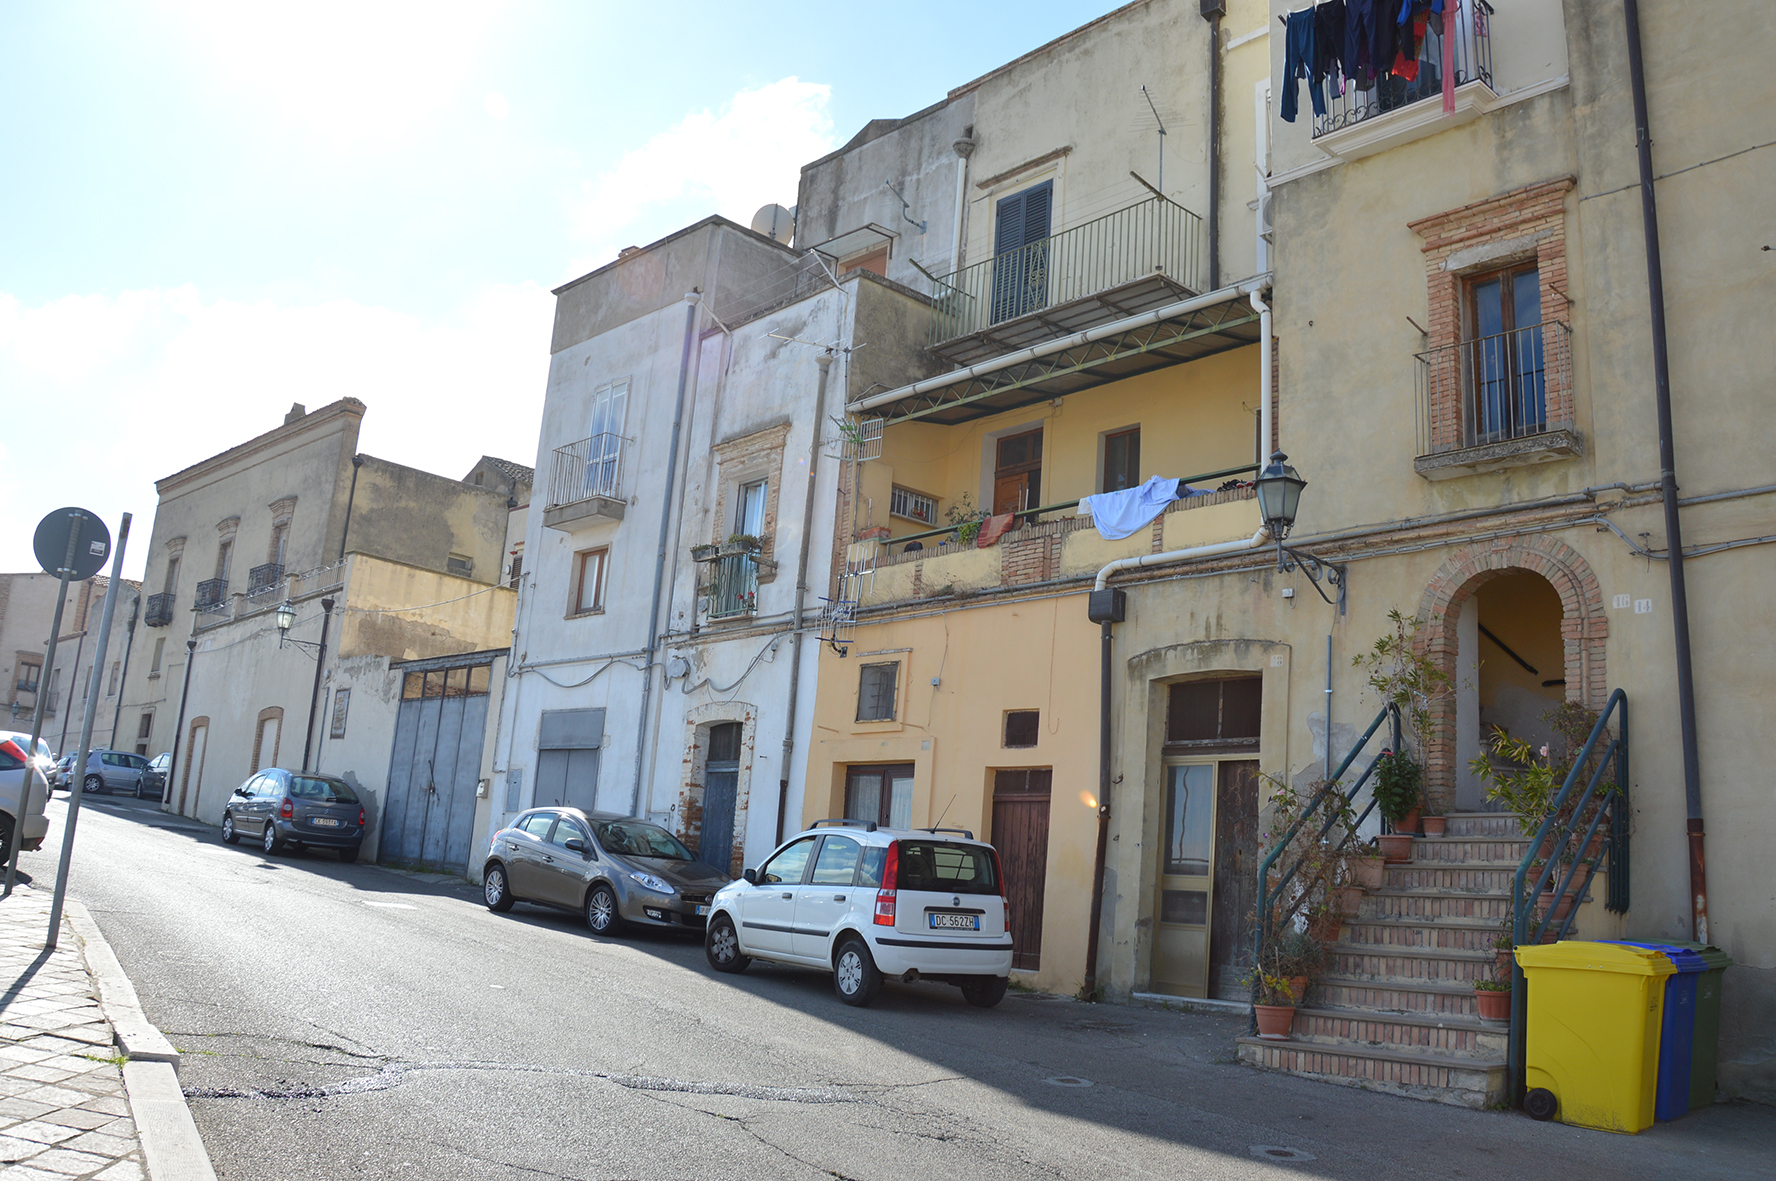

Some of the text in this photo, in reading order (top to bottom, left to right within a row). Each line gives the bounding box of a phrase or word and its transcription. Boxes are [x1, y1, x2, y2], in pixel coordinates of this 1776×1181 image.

[1616, 595, 1629, 607] 16
[1638, 600, 1651, 612] 14
[936, 915, 974, 927] DC 562ZH
